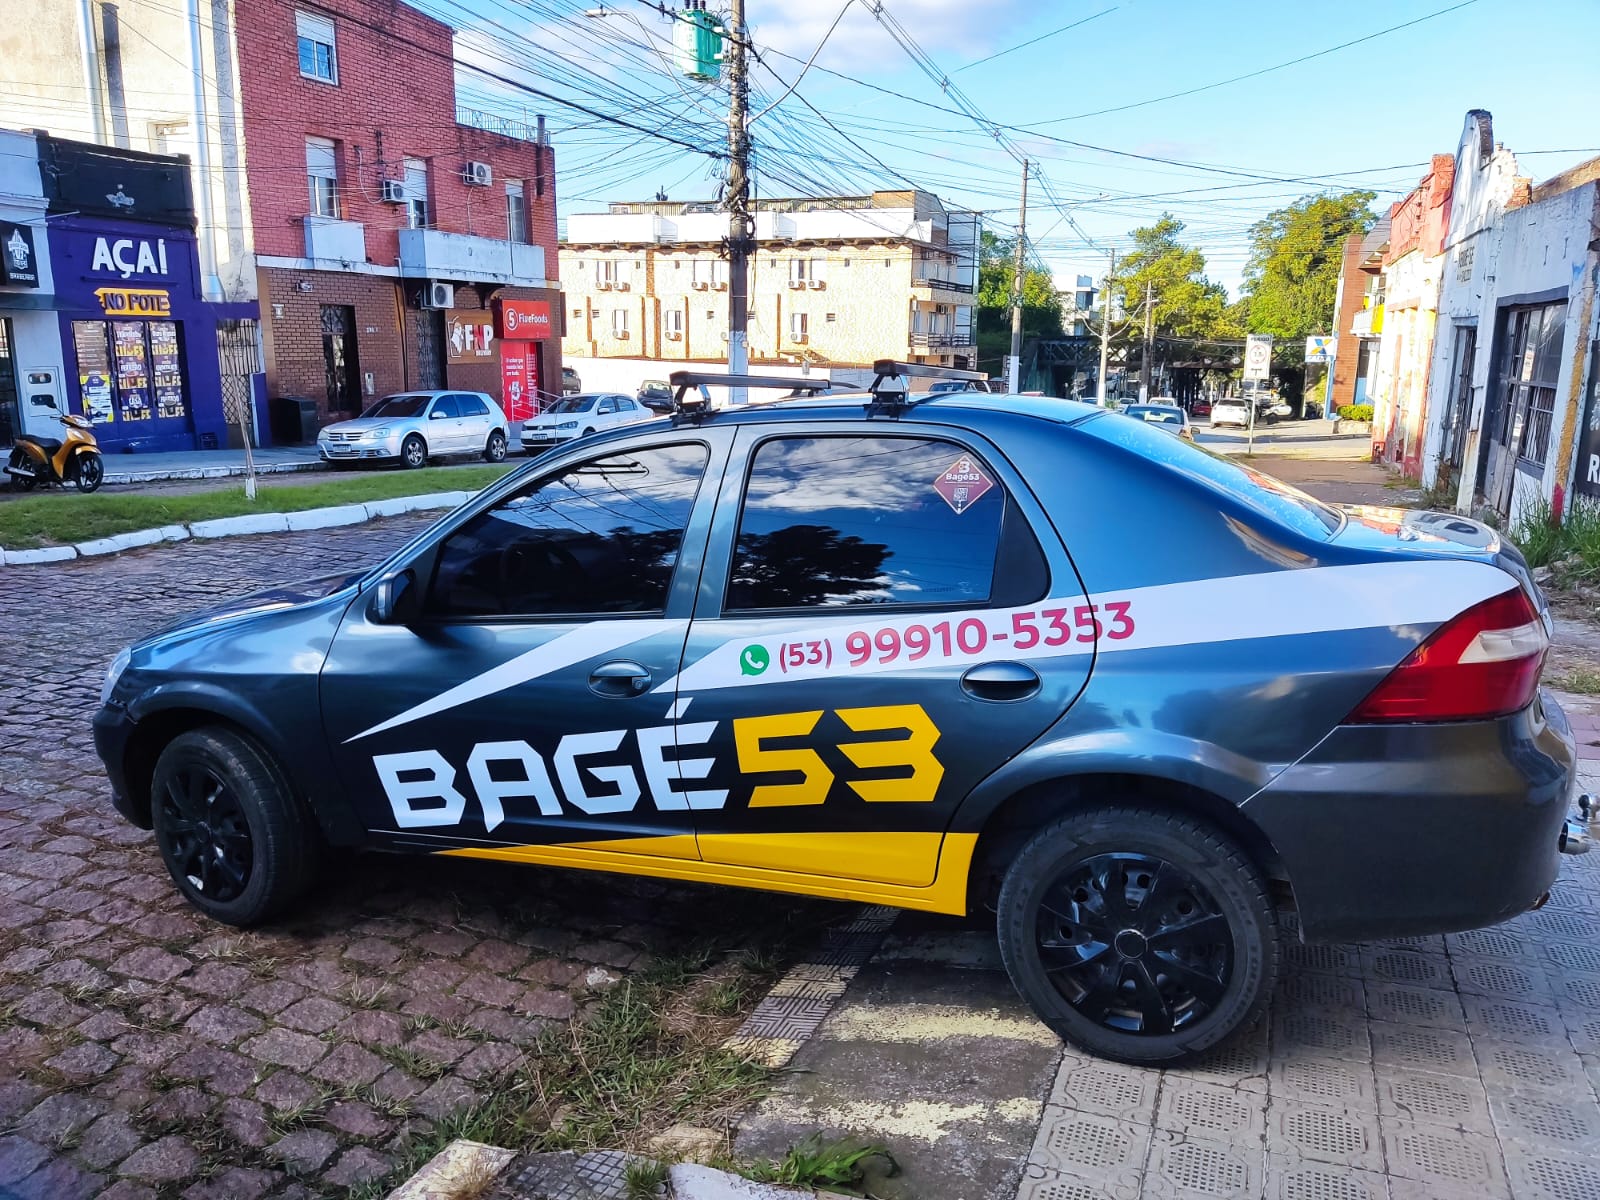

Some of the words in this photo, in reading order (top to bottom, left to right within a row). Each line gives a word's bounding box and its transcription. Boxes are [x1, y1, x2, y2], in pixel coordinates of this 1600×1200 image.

[92, 237, 168, 279] AÇAÍ
[104, 293, 126, 310] NO
[128, 294, 169, 312] POTE
[518, 313, 548, 323] FiveFoods
[464, 324, 494, 351] FNP
[779, 638, 833, 674] (53)
[845, 601, 1135, 668] 99910-5353
